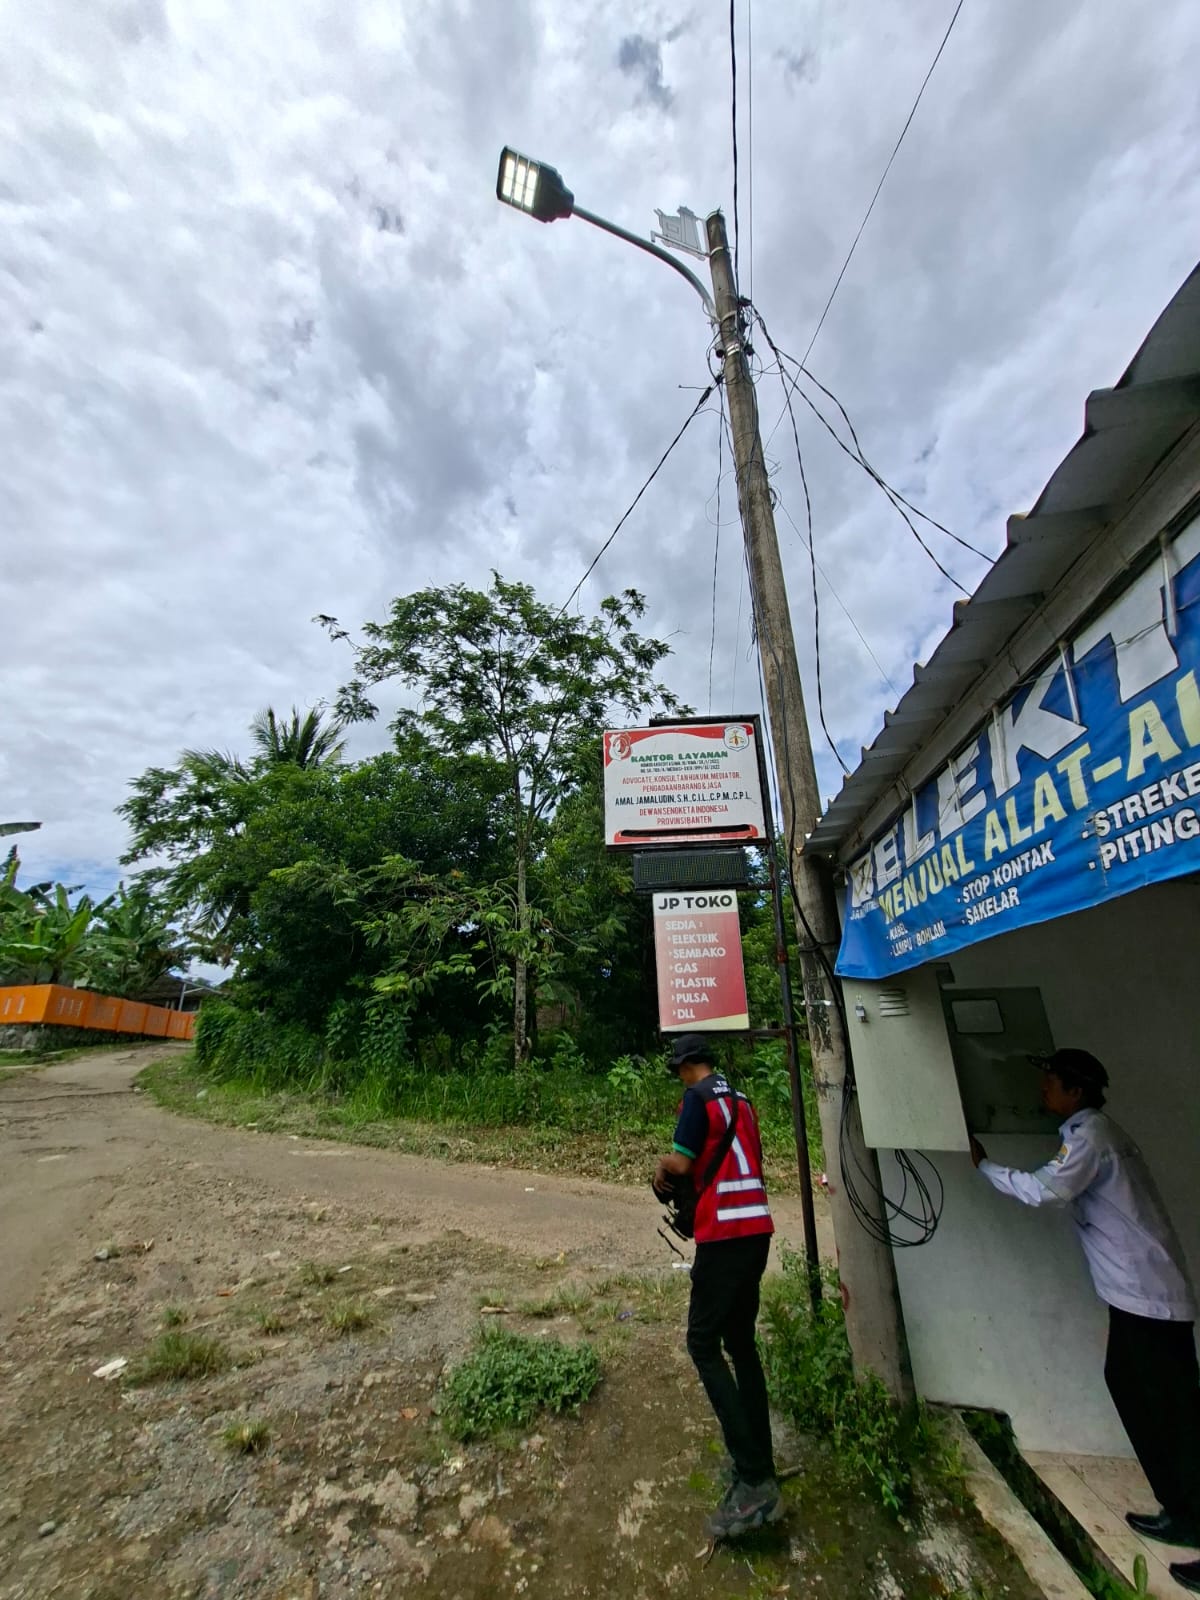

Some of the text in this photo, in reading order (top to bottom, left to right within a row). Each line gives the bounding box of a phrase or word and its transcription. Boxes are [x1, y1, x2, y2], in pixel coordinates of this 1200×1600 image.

[631, 754, 674, 763] KANTOR
[678, 751, 729, 760] LAYANAN
[707, 781, 722, 790] JASA
[614, 796, 635, 806] AMAL
[962, 840, 1056, 904] STOP KONTAK
[879, 833, 975, 925] MENJUAL
[658, 894, 733, 910] JP TOKO
[965, 886, 1020, 926] SAKELAR
[665, 920, 697, 931] SEDIA
[889, 922, 909, 941] KABEL
[672, 932, 719, 945] ELEKTRIK
[892, 920, 946, 957] LAMPU BOHLAM
[672, 946, 726, 960] SEMBAKO
[674, 962, 698, 974] GAS
[674, 976, 717, 988] PLASTIK
[676, 992, 710, 1003] PULSA
[677, 1008, 696, 1019] DLL
